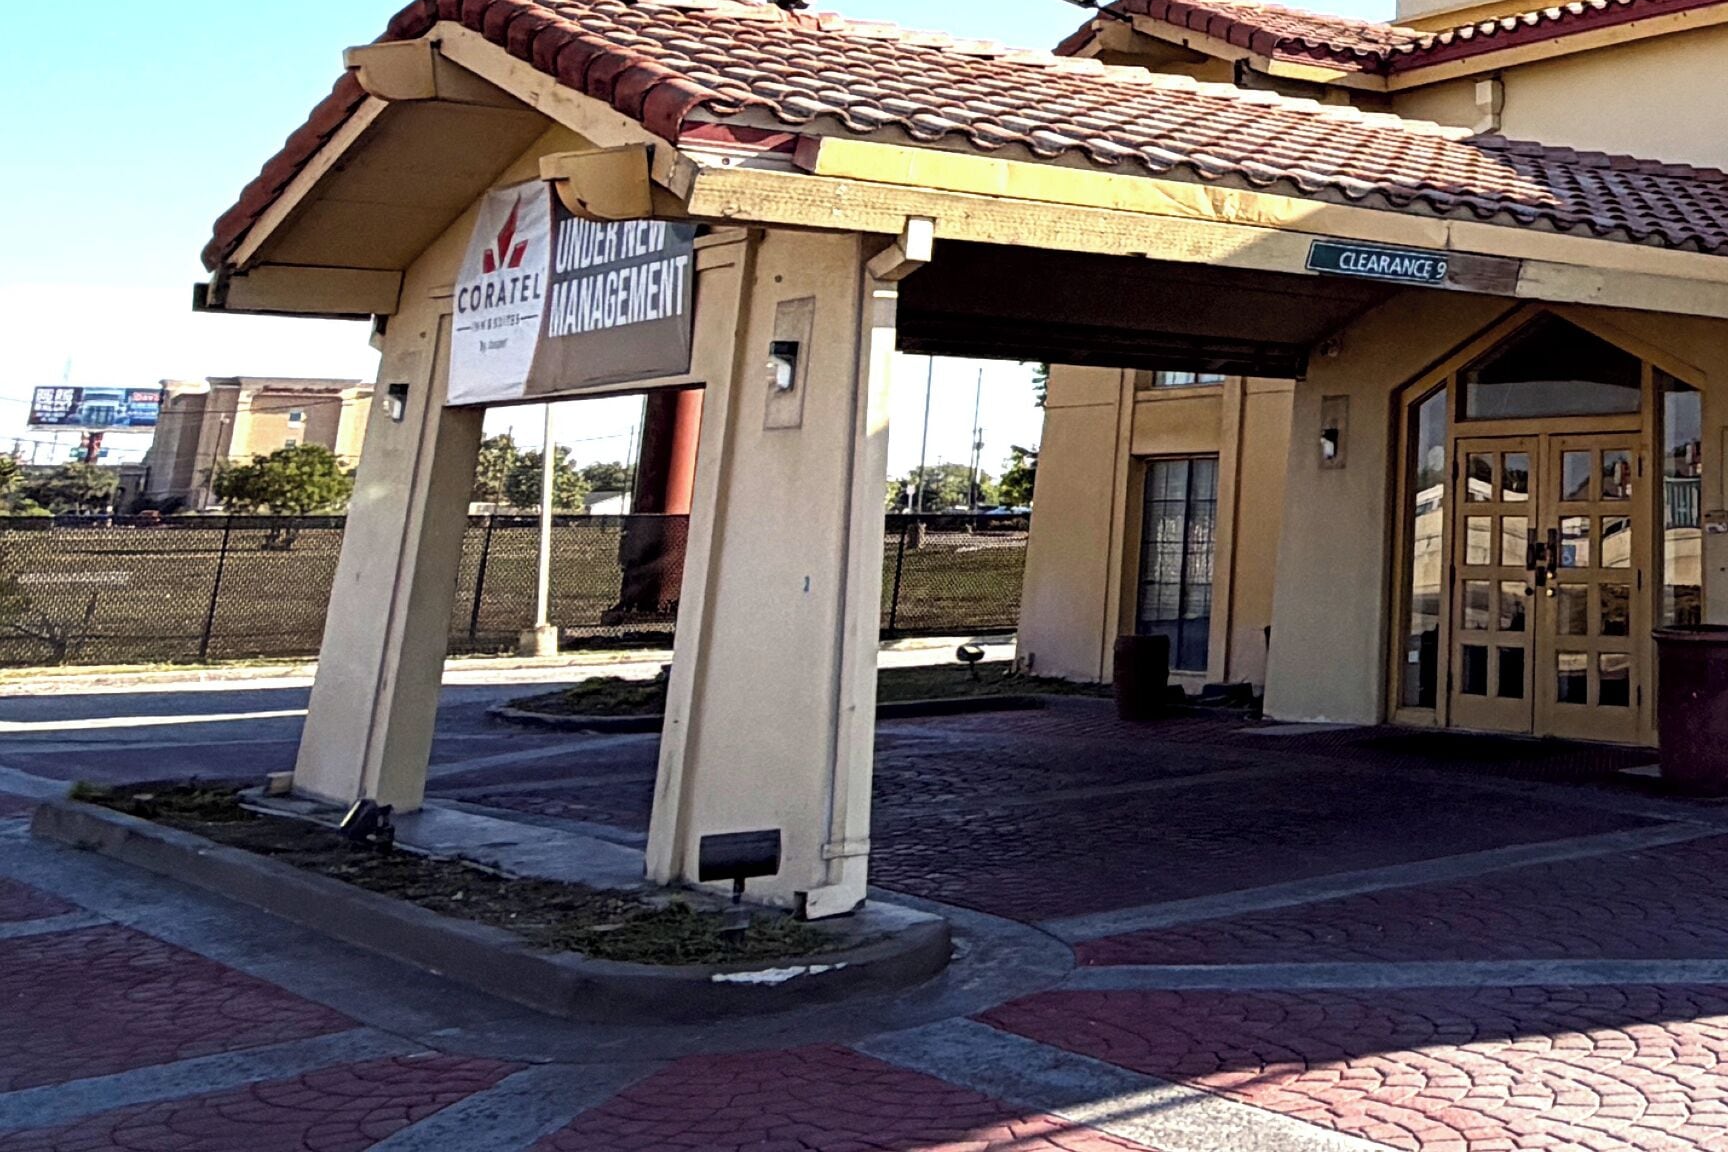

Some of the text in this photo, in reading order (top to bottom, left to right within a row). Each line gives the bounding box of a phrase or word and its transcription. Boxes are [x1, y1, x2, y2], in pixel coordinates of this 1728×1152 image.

[555, 217, 667, 273] UNDER NEW
[1340, 251, 1448, 279] CLEARANCE 9
[457, 273, 541, 314] CORATEL
[549, 255, 688, 337] MANAGEMENT
